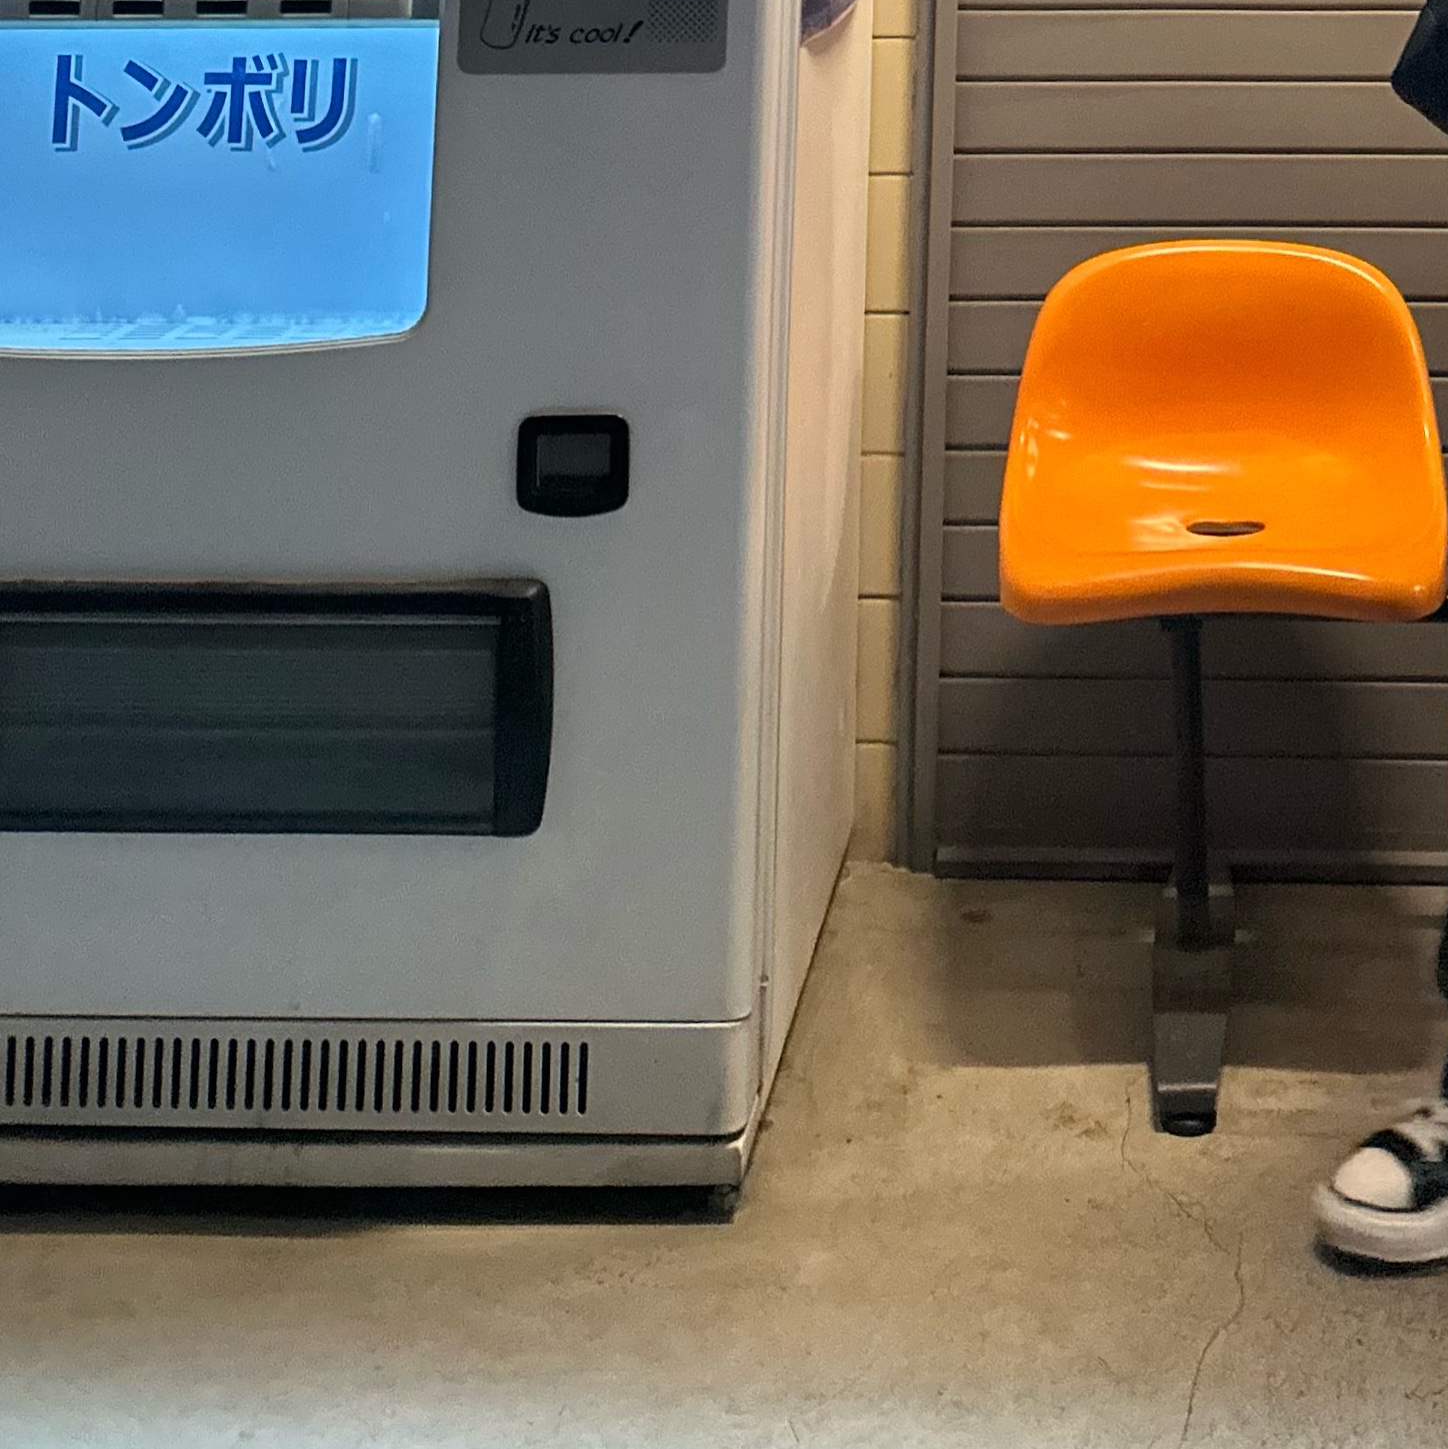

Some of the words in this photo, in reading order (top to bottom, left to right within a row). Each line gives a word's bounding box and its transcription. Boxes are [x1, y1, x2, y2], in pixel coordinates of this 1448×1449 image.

[525, 23, 560, 44] It's
[569, 20, 644, 44] cool!
[52, 53, 350, 146] トンボリ
